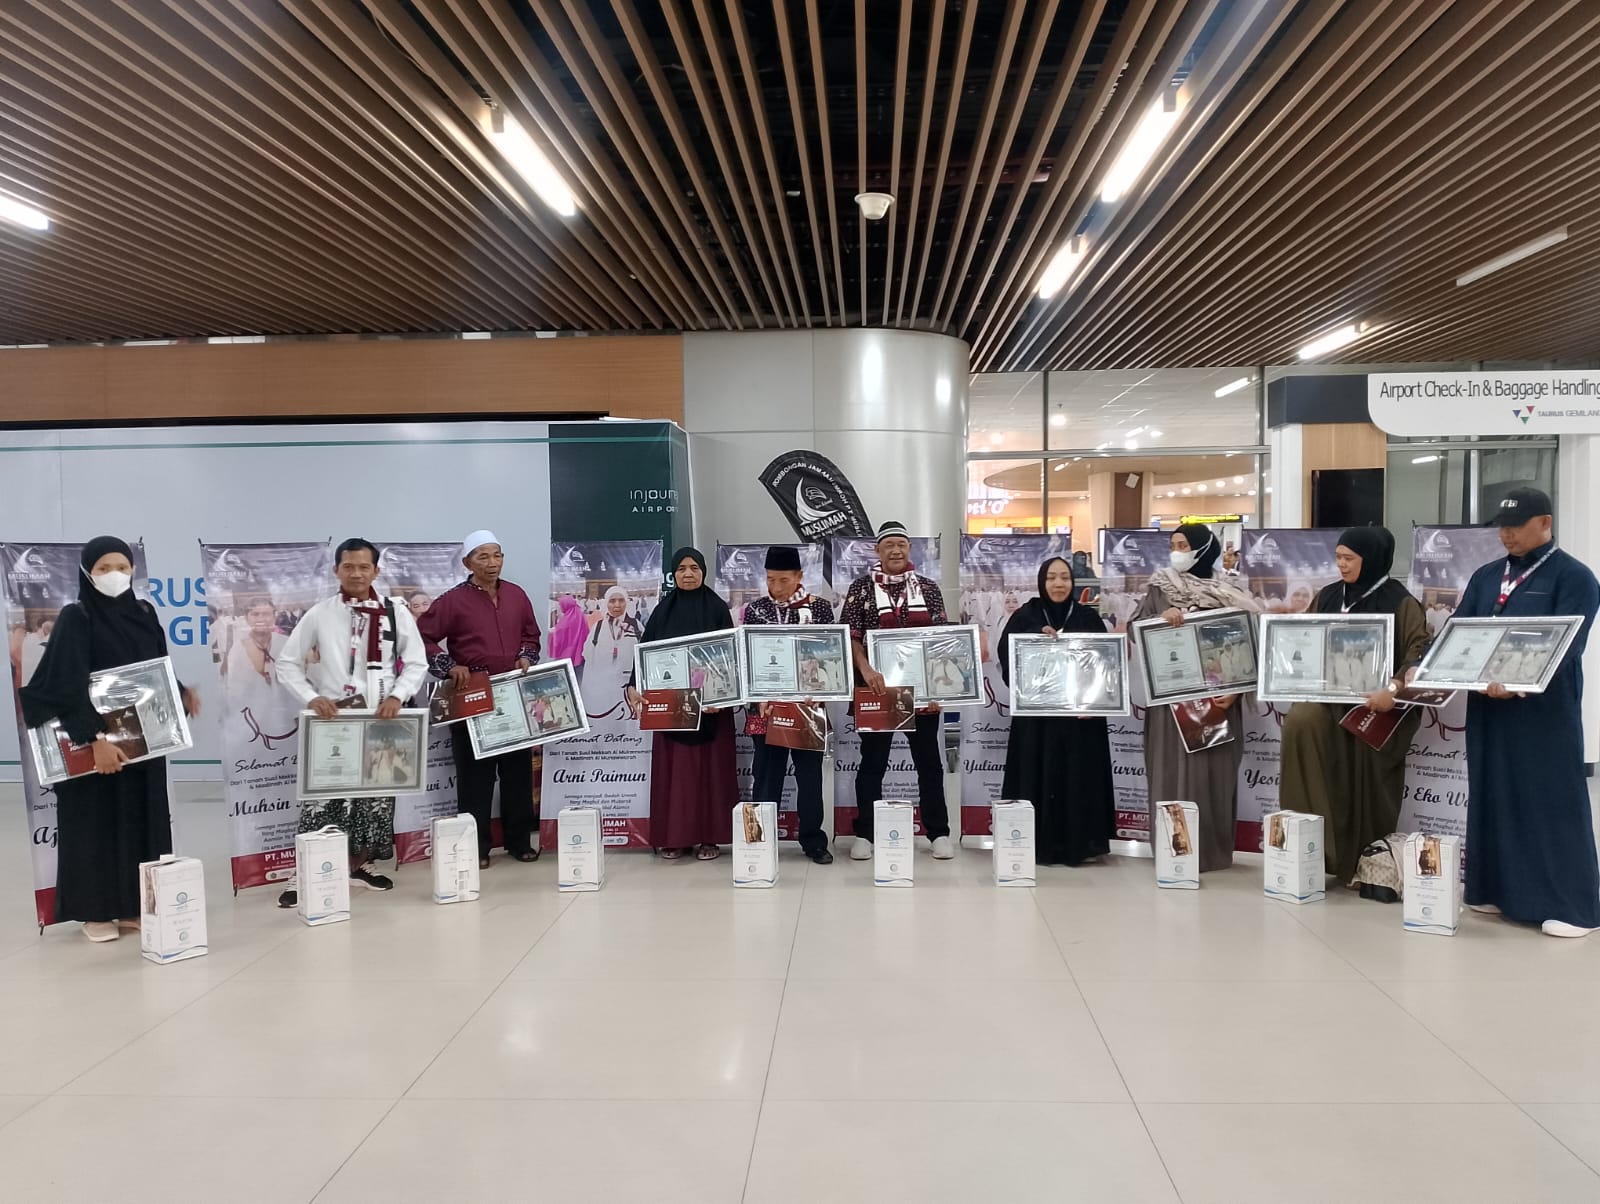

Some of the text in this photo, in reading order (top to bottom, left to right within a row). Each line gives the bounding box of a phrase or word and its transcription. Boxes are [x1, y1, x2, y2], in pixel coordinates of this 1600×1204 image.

[1379, 381, 1423, 402] Airport
[1424, 379, 1481, 398] Check-In
[1482, 379, 1494, 397] &
[1495, 379, 1549, 400] Baggage
[800, 511, 848, 537] MUSLIMAH
[603, 732, 643, 747] Datang
[1406, 743, 1460, 760] Selamat
[234, 756, 289, 774] Selamat
[552, 768, 647, 784] Arni Paimun
[229, 798, 291, 818] Muhsin
[264, 852, 279, 862] PT.
